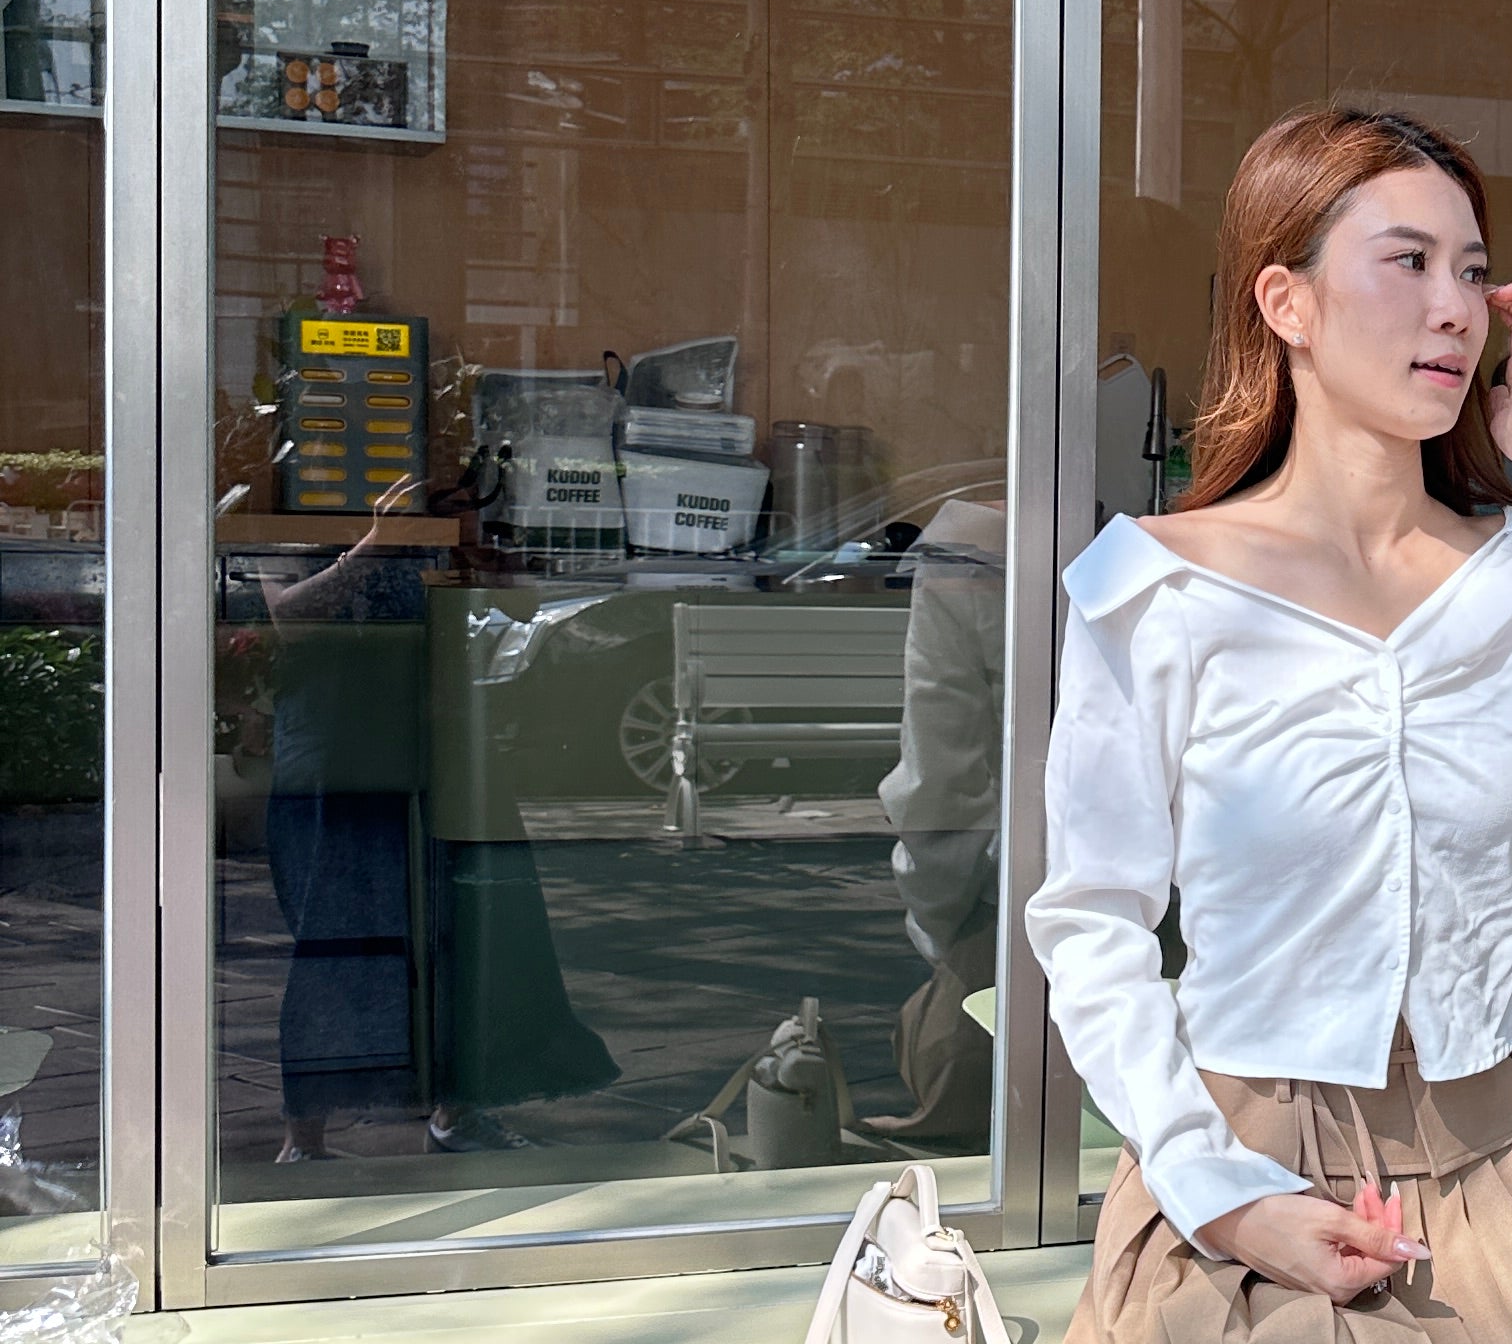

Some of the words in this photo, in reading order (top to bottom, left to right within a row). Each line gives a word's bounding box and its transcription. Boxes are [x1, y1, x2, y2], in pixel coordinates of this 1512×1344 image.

[547, 468, 601, 485] KUDDO
[546, 487, 601, 504] COFFEE
[676, 493, 731, 513] KUDDO
[674, 512, 729, 531] COFFEE
